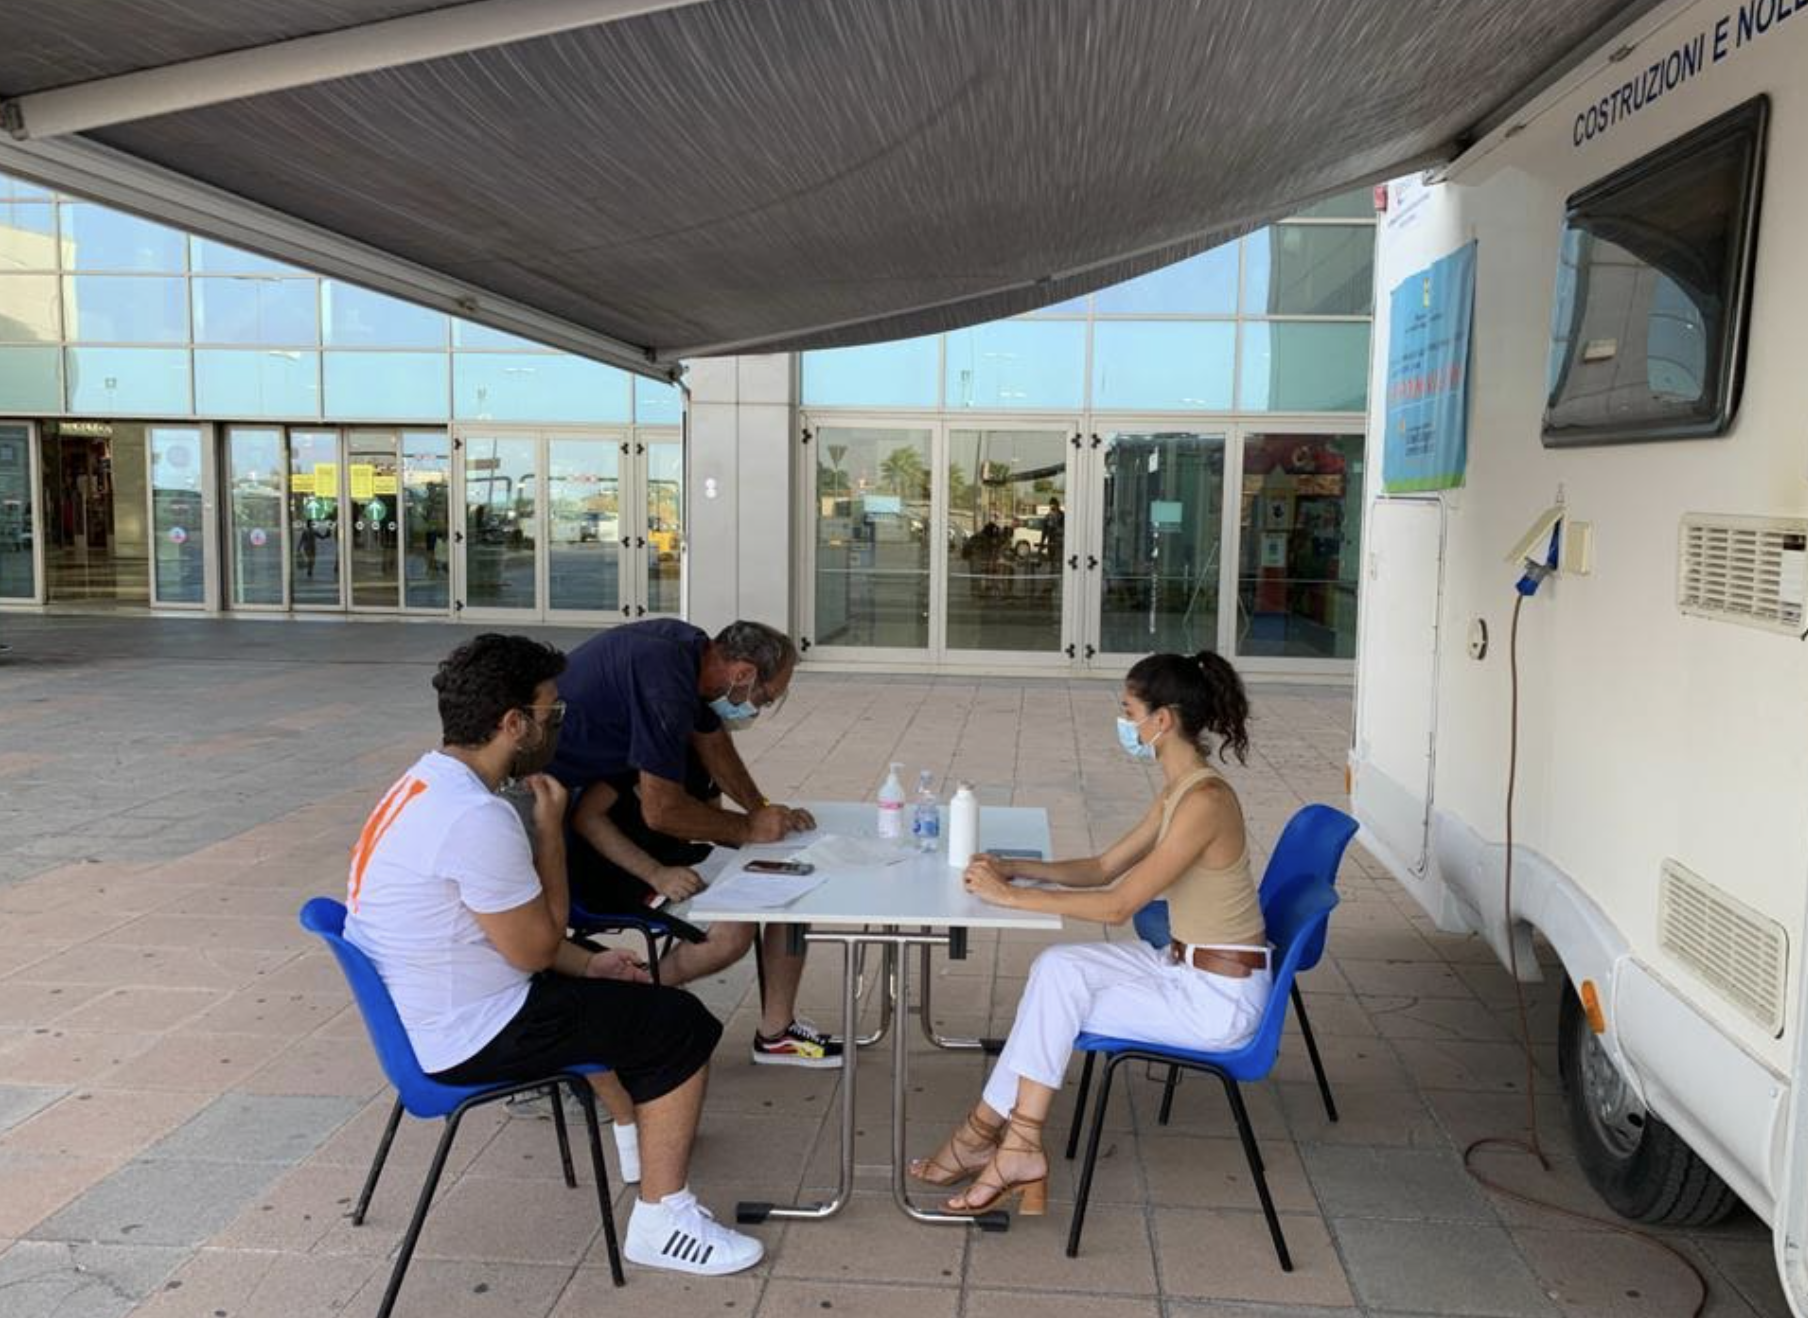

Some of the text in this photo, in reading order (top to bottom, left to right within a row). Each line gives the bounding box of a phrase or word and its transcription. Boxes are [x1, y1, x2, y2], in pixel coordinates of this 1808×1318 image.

[1573, 0, 1808, 147] COSTRUZIONI E NOL
